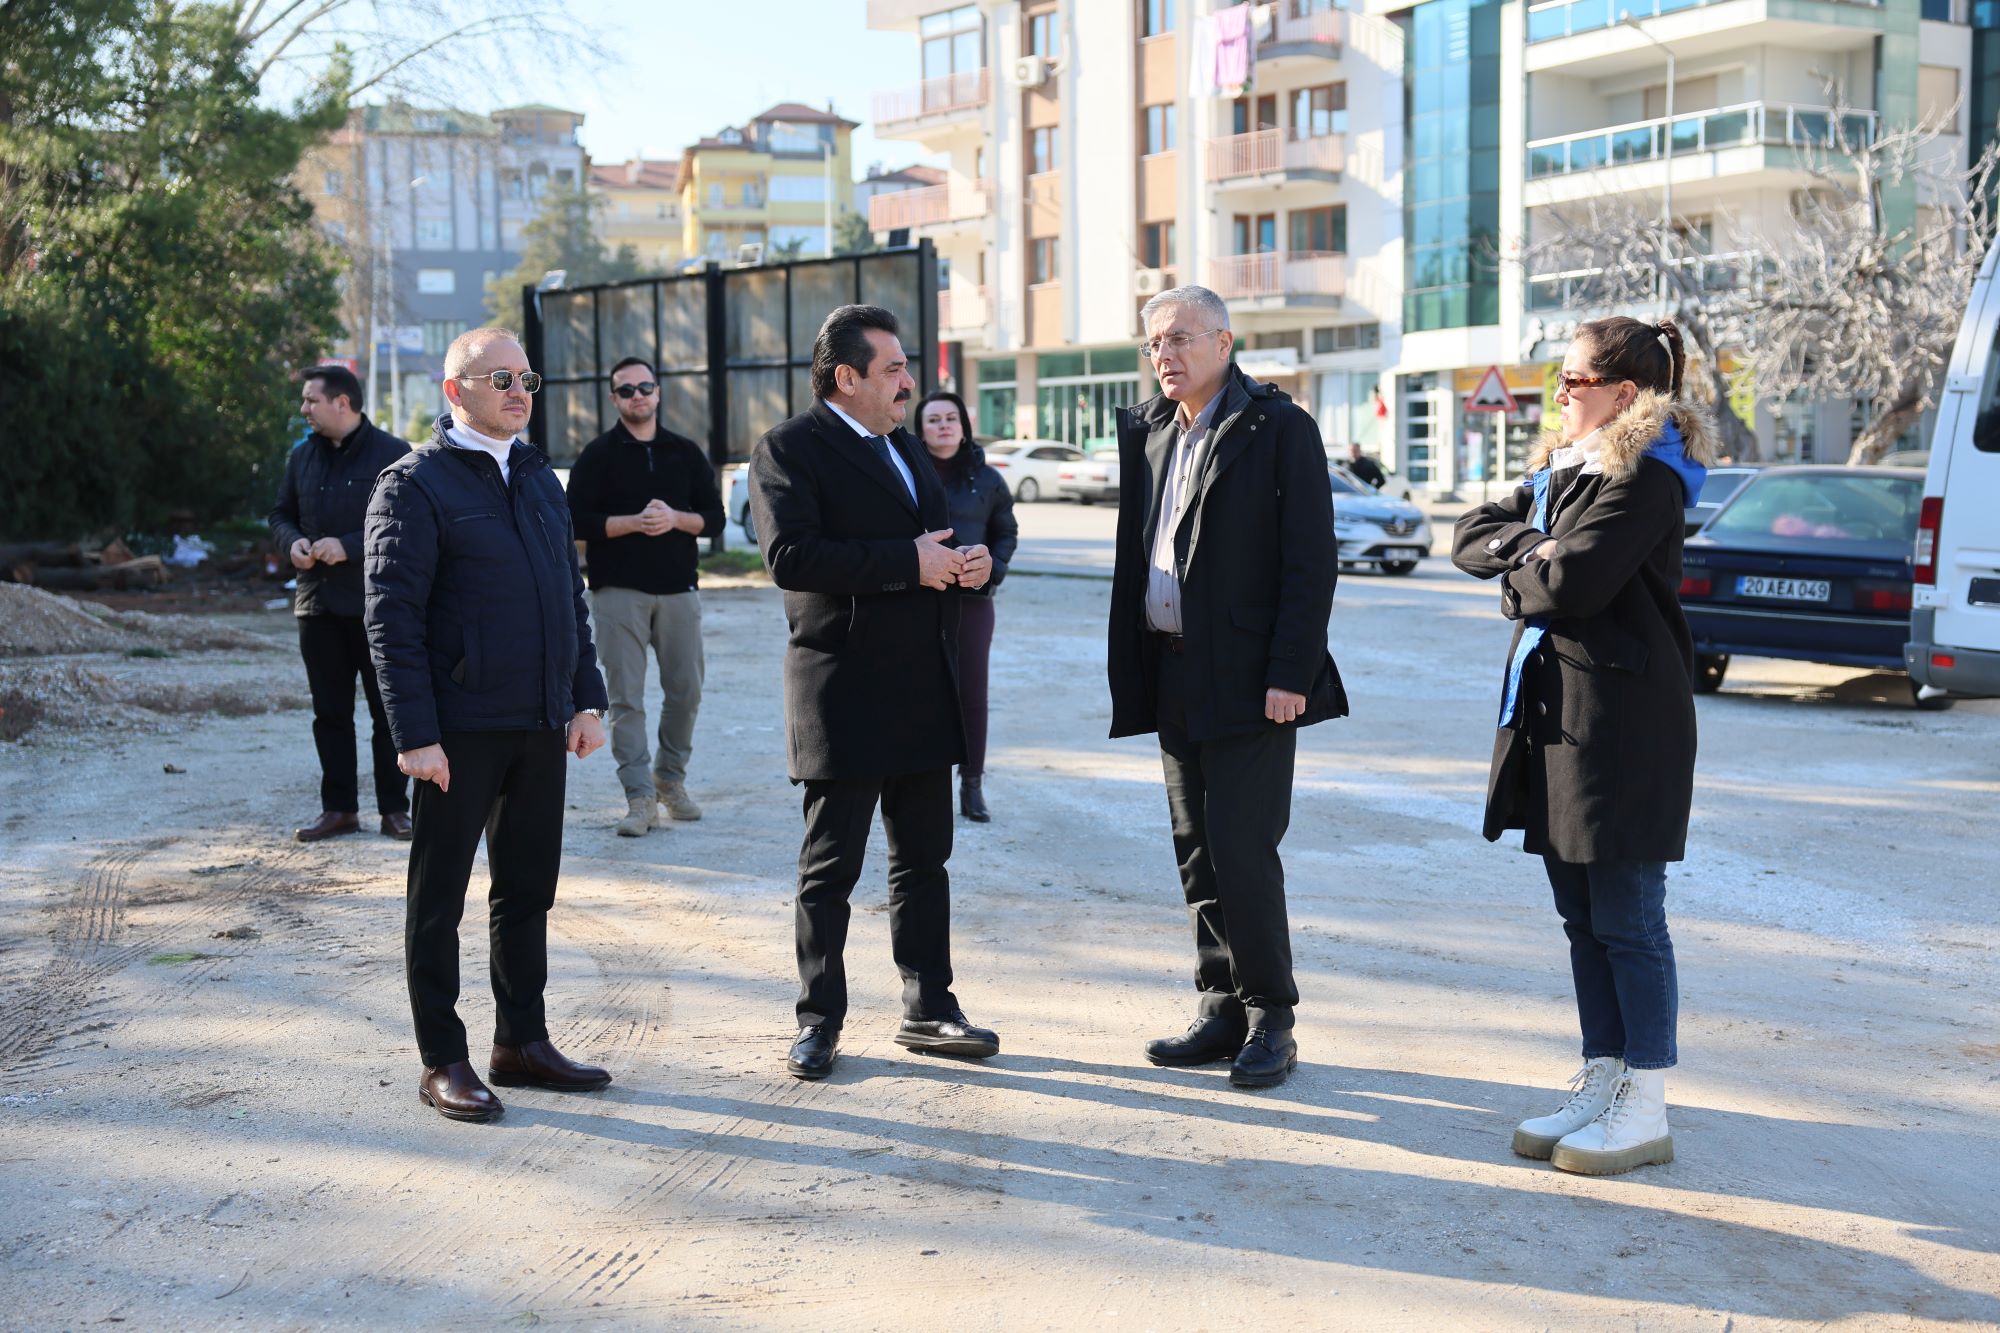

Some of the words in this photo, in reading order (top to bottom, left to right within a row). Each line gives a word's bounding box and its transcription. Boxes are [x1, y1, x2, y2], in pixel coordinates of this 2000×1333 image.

[1745, 577, 1764, 593] 20
[1767, 580, 1795, 596] AEA
[1799, 581, 1829, 598] 049
